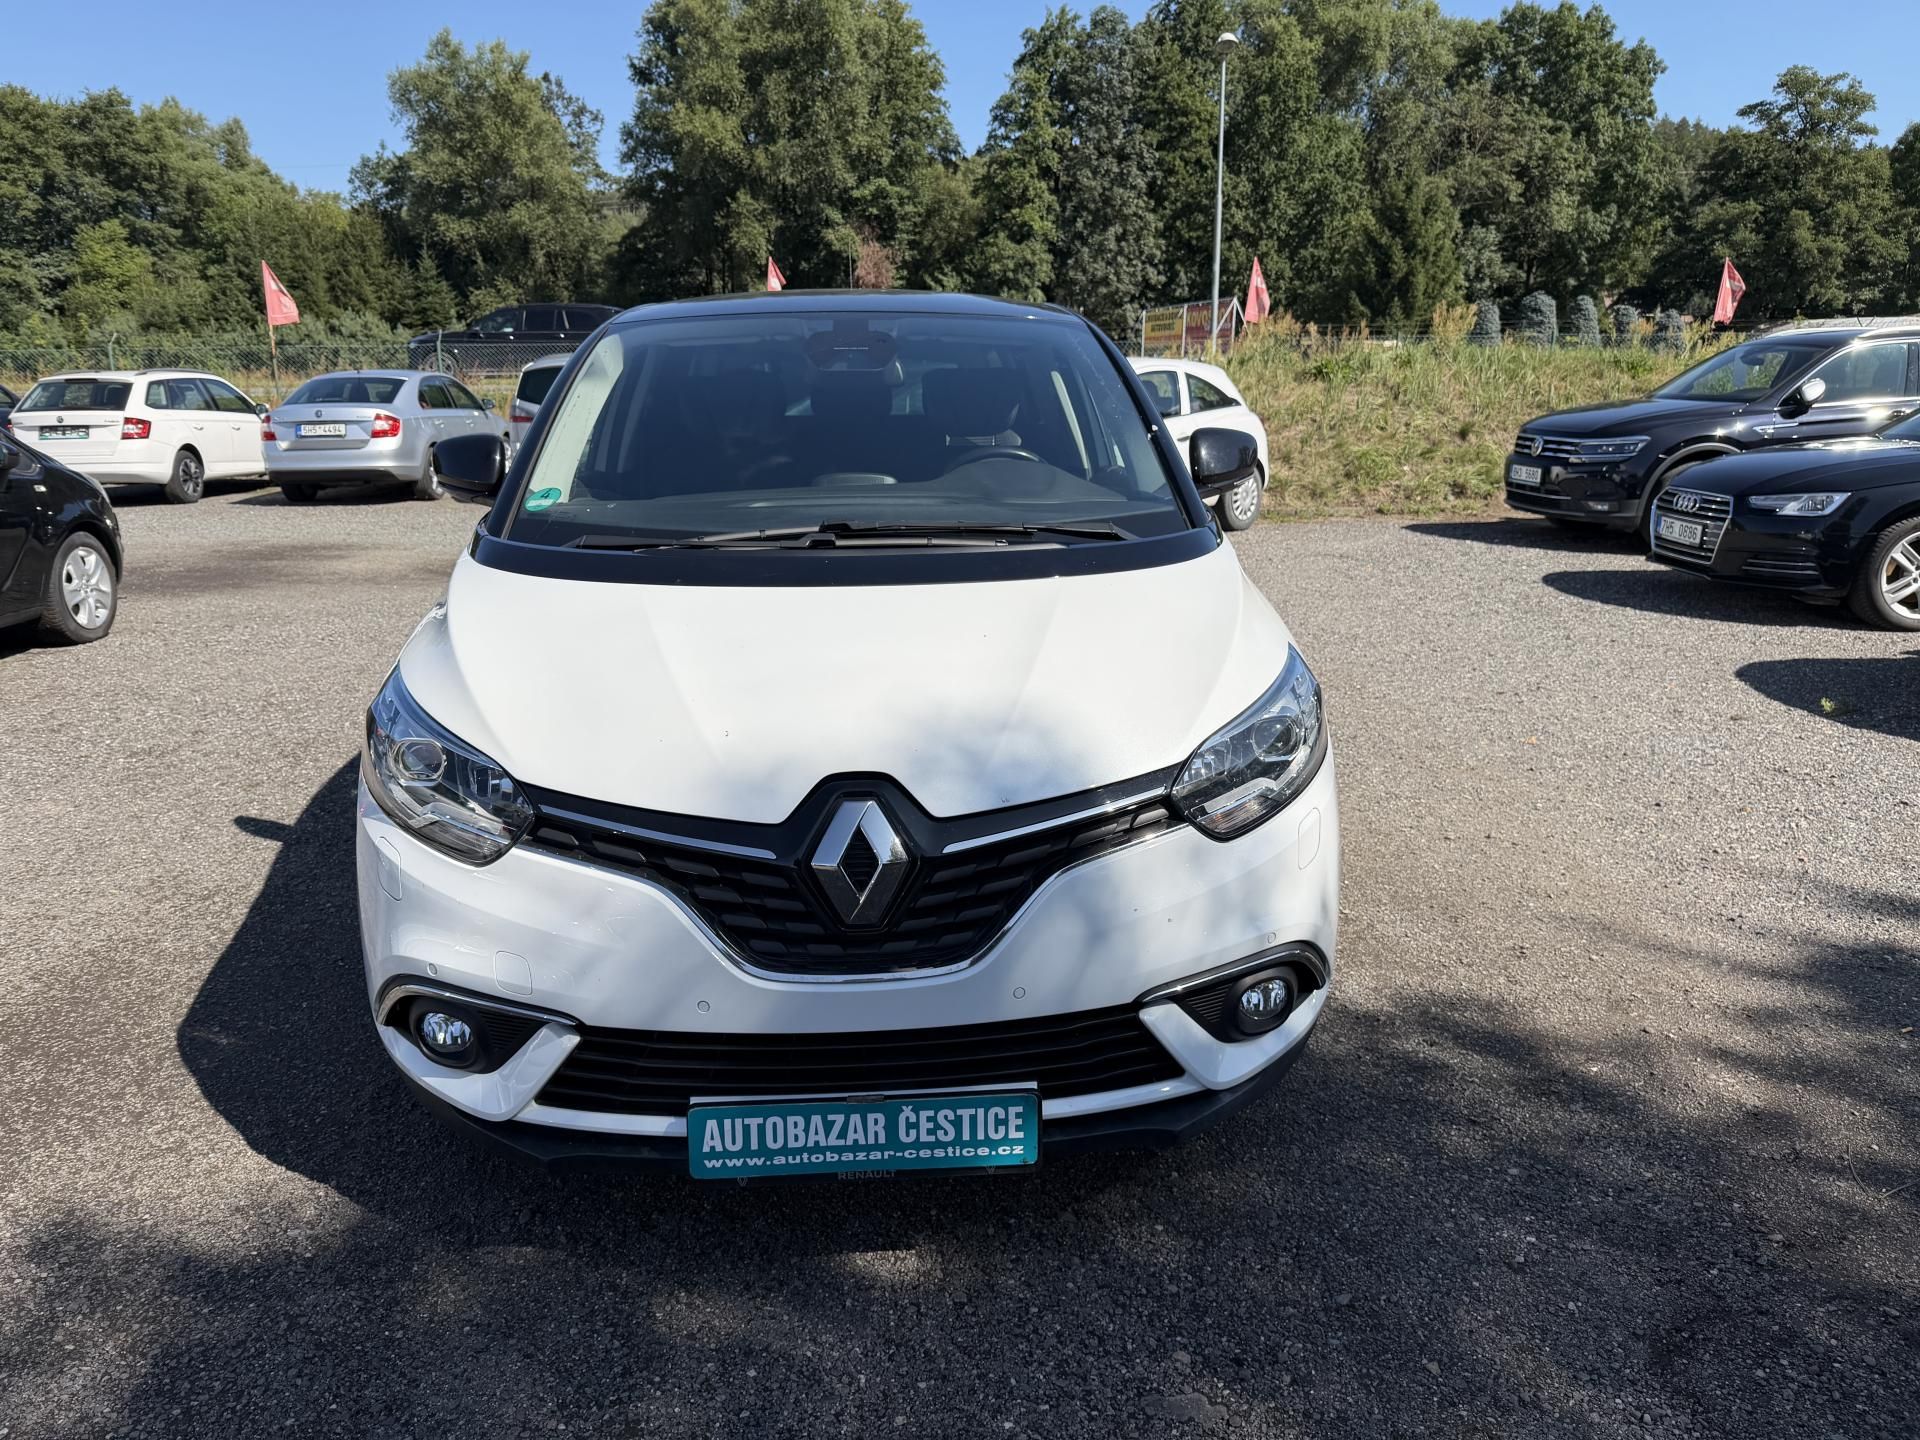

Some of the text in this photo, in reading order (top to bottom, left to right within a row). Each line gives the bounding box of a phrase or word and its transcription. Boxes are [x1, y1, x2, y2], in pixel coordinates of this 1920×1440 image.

[322, 426, 342, 434] 4494
[540, 488, 553, 499] 4
[1662, 519, 1675, 535] 7H5
[702, 1105, 1025, 1153] AUTOBAZAR ČESTICE
[703, 1145, 1025, 1169] www.autobazar-cestice.cz
[838, 1169, 896, 1180] RENAULT
